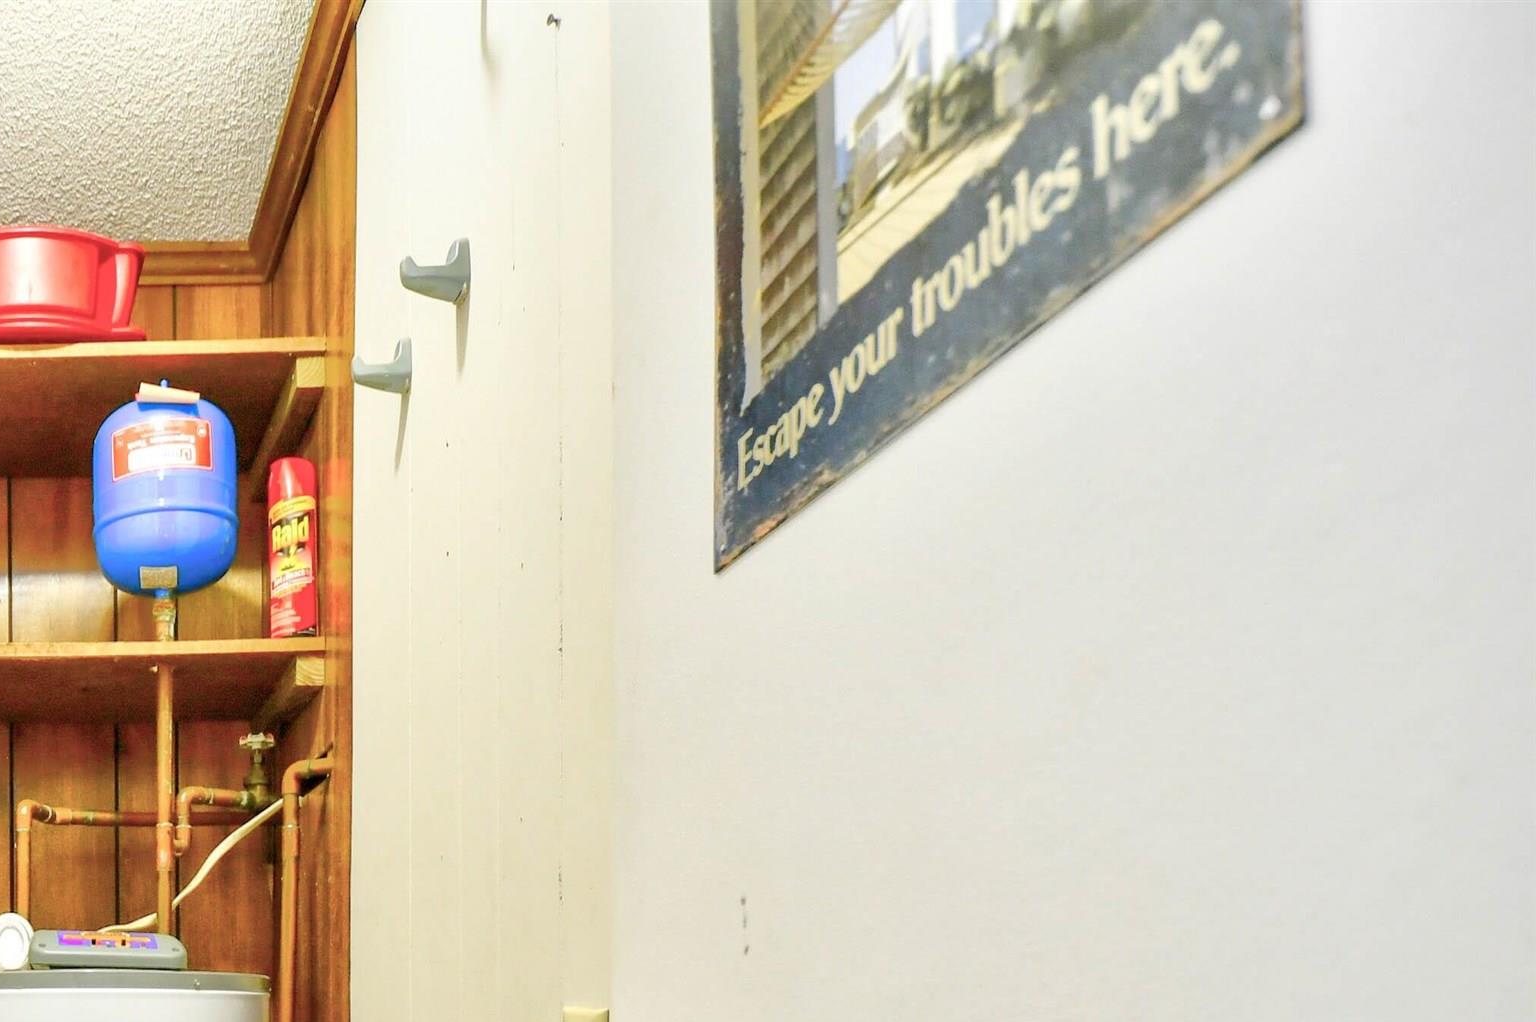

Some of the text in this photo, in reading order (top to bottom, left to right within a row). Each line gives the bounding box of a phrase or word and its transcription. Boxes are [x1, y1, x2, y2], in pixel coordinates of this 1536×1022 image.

[737, 18, 1241, 490] Escape your troubles here.
[272, 515, 310, 553] Raid
